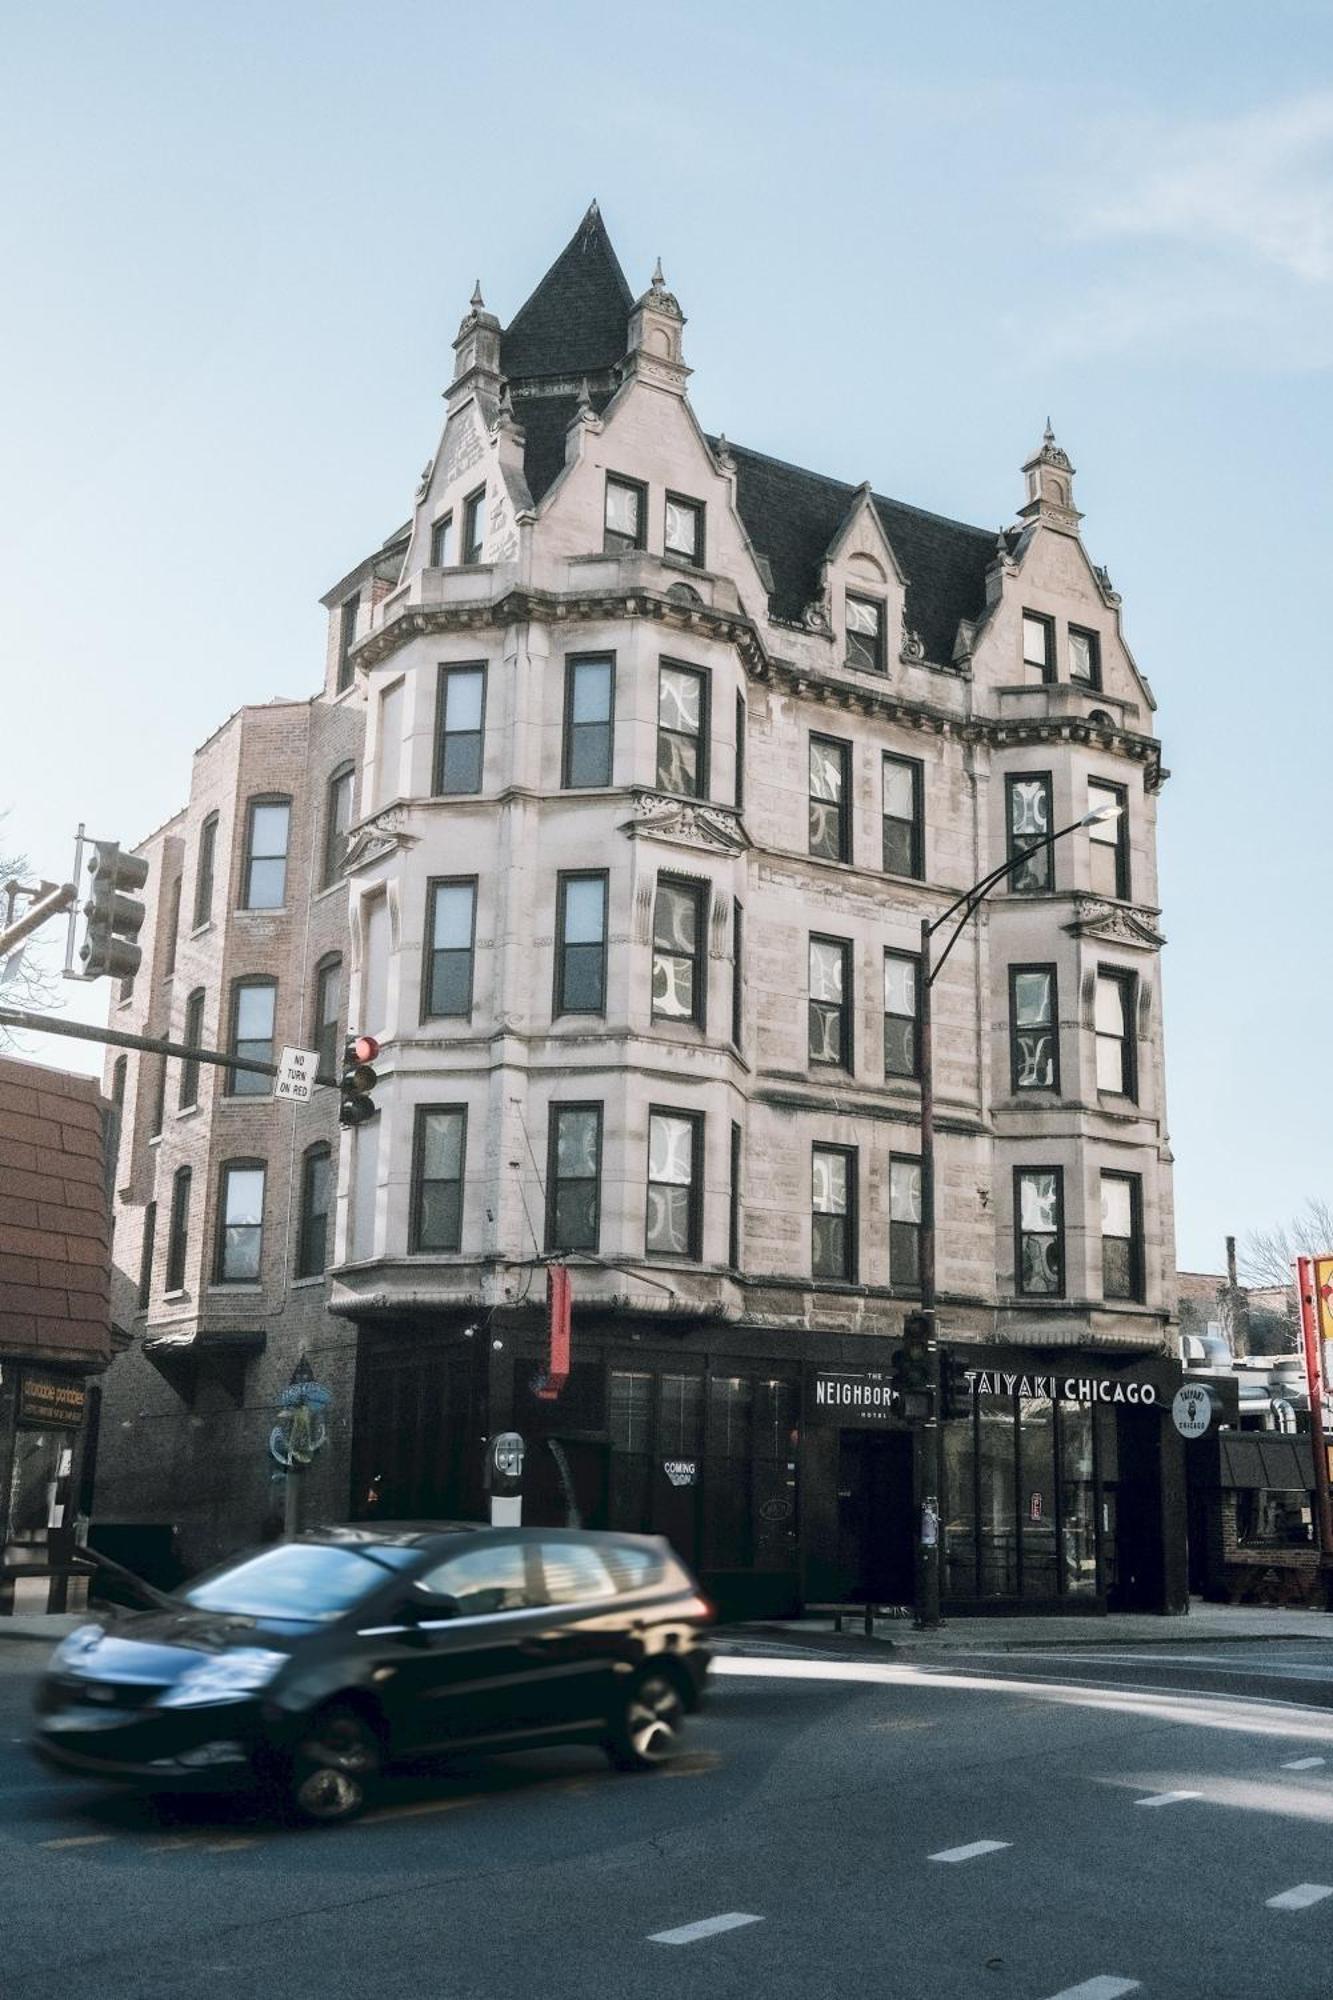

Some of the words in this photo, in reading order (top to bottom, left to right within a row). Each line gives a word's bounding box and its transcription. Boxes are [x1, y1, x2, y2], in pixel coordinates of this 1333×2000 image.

[294, 1055, 305, 1066] NO
[287, 1068, 306, 1081] TURN
[280, 1082, 290, 1094] ON
[293, 1084, 307, 1097] RED
[867, 1372, 882, 1380] THE
[816, 1380, 900, 1406] NEIGHBOR
[964, 1371, 1056, 1399] TAIYAKI
[1064, 1378, 1156, 1405] CHICAGO
[664, 1462, 696, 1474] COMING
